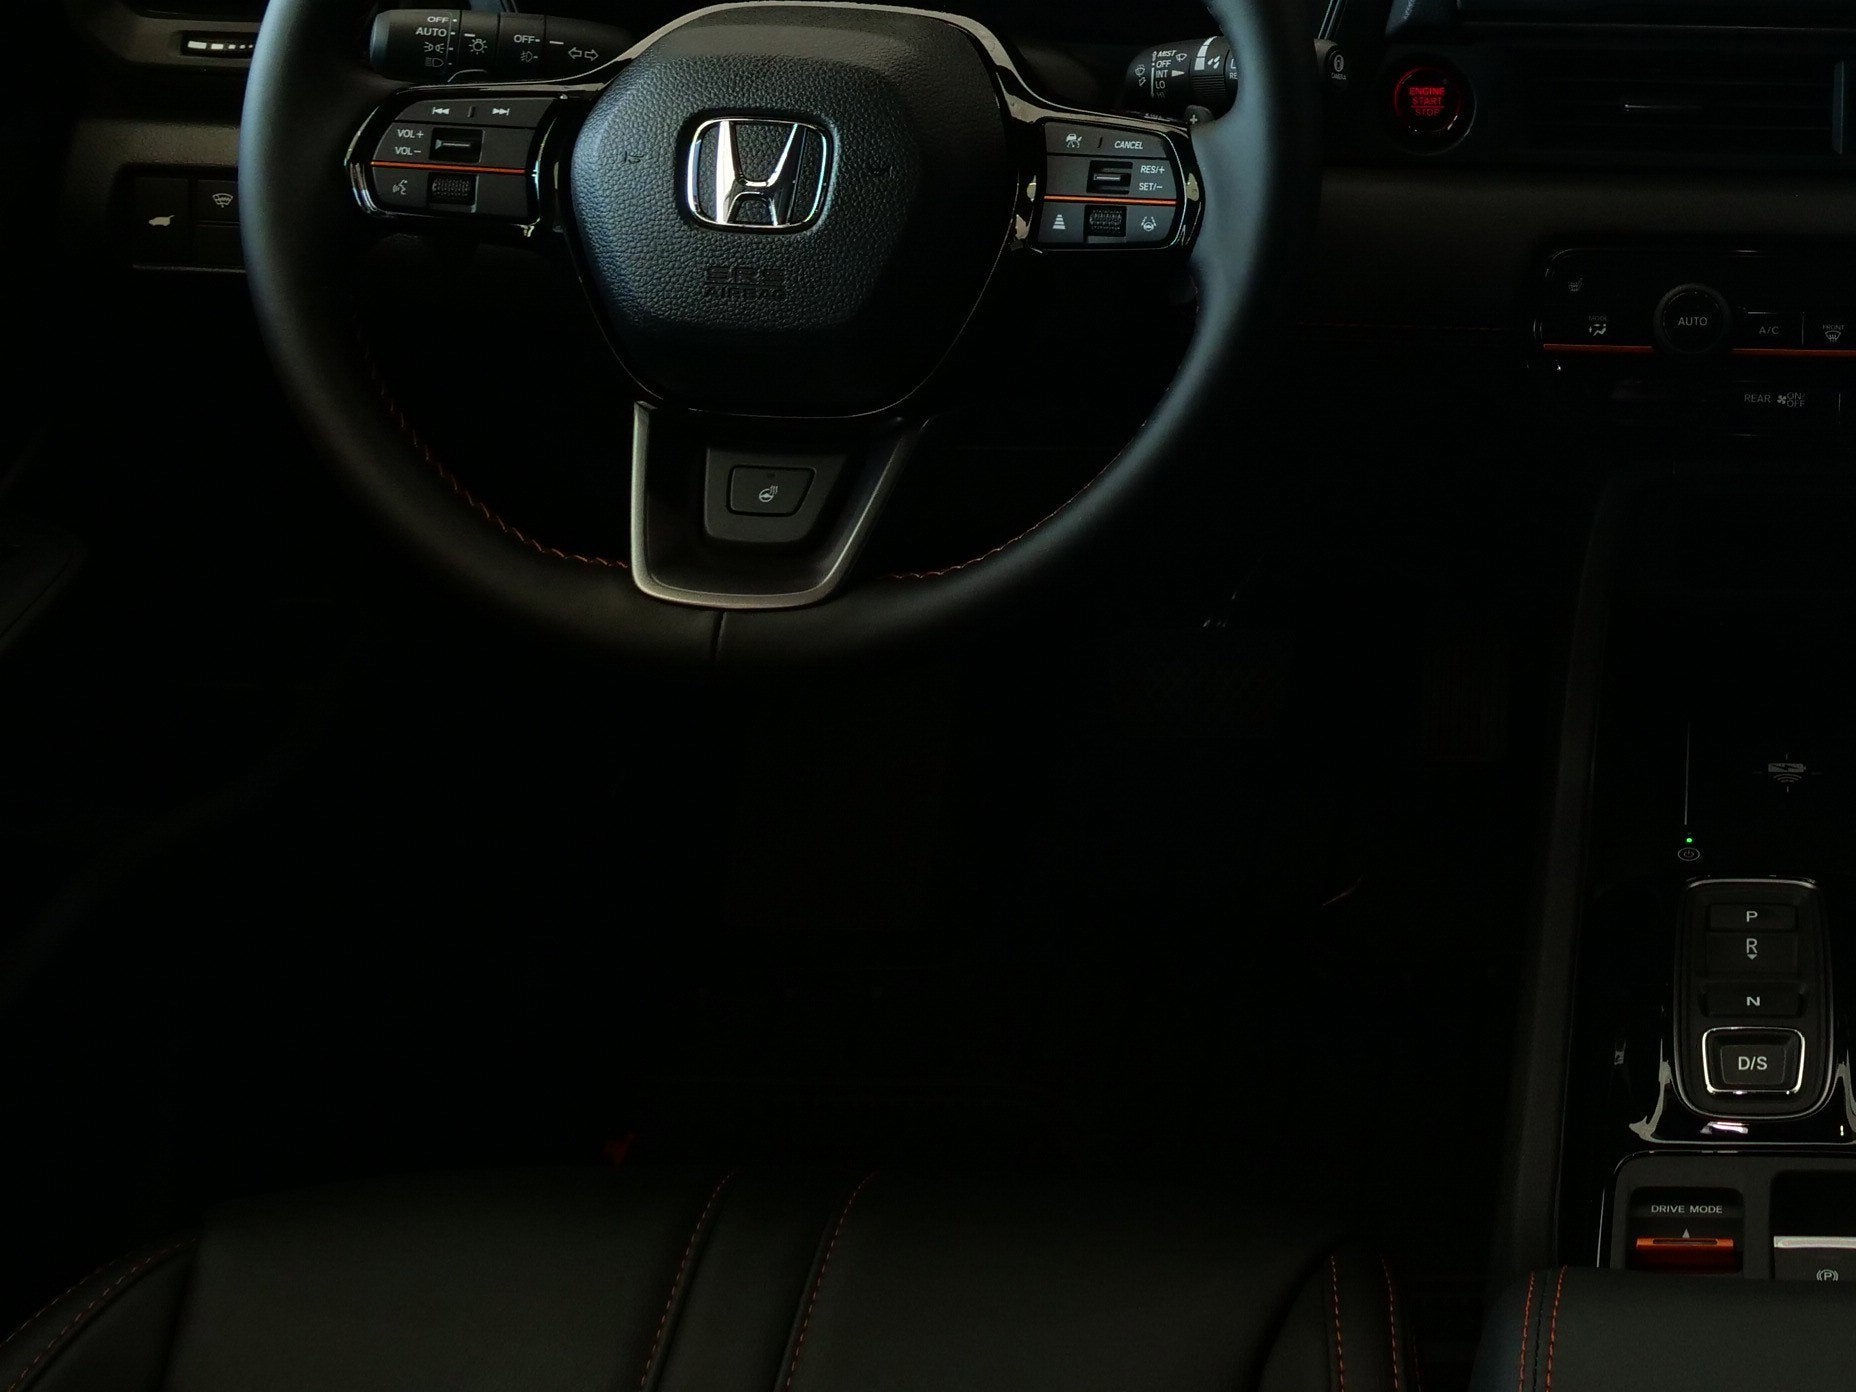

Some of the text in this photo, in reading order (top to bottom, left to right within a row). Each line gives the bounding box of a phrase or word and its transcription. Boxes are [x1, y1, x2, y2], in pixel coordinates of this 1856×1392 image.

[416, 27, 447, 37] AUTO
[514, 34, 534, 43] OFF
[1156, 60, 1171, 68] OFF
[1156, 69, 1168, 78] INT
[1156, 80, 1166, 89] LO
[1114, 141, 1143, 150] CANCEL
[1677, 316, 1708, 327] AUTO
[1759, 326, 1779, 336] A/C
[1744, 394, 1771, 403] REAR
[1746, 910, 1758, 922] P
[1746, 938, 1758, 953] R
[1746, 996, 1760, 1006] N
[1738, 1056, 1768, 1070] D/S
[1651, 1205, 1722, 1214] DRIVE MODE
